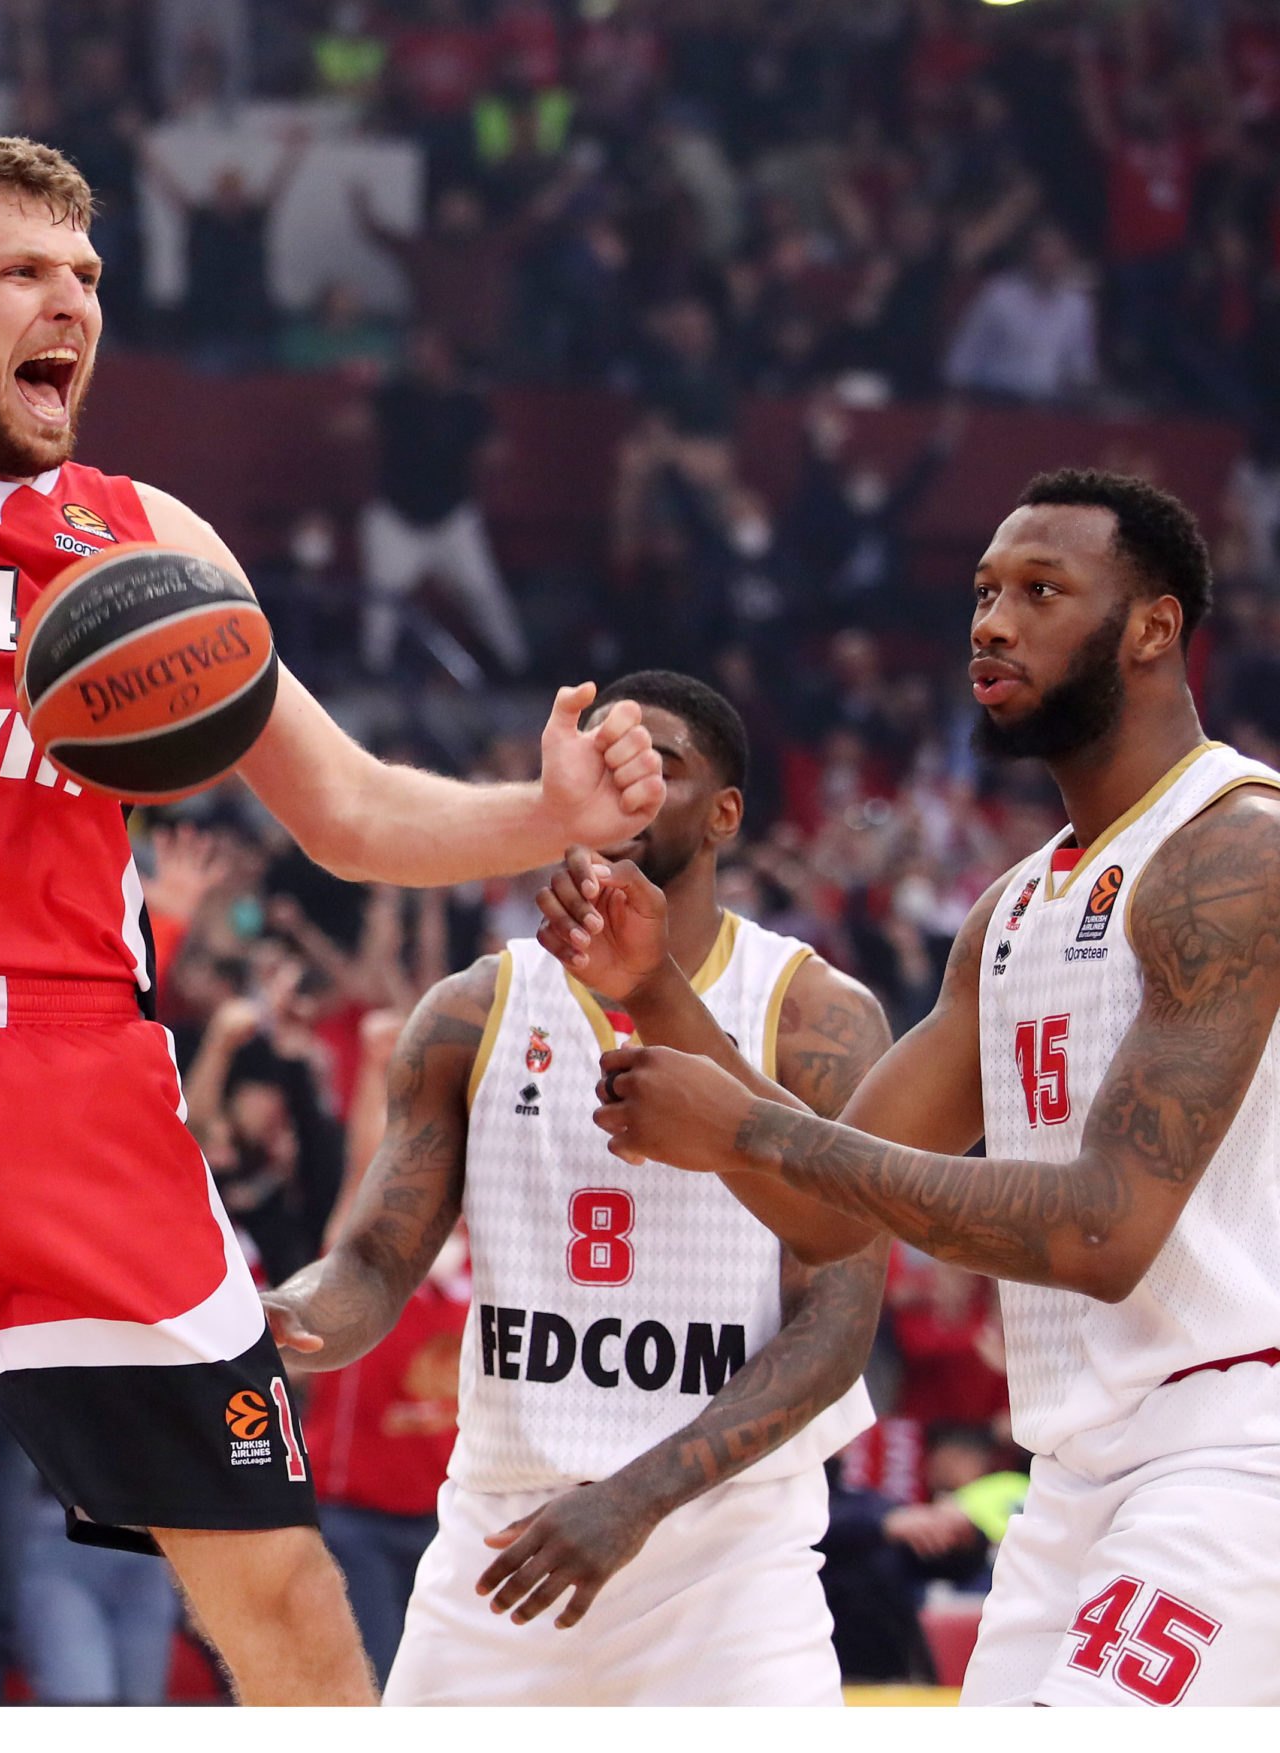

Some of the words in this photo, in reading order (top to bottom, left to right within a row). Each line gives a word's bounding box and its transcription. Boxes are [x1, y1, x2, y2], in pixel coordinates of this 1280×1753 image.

[55, 534, 104, 556] 10on
[78, 617, 251, 722] SPALDING
[1015, 1013, 1071, 1129] 45
[566, 1187, 635, 1287] 8
[480, 1304, 746, 1396] FEDCOM
[230, 1440, 270, 1450] TURKISH
[231, 1448, 271, 1458] AIRLINES
[231, 1457, 272, 1466] EuroLeague
[269, 1376, 308, 1482] 1
[1067, 1574, 1223, 1706] 45
